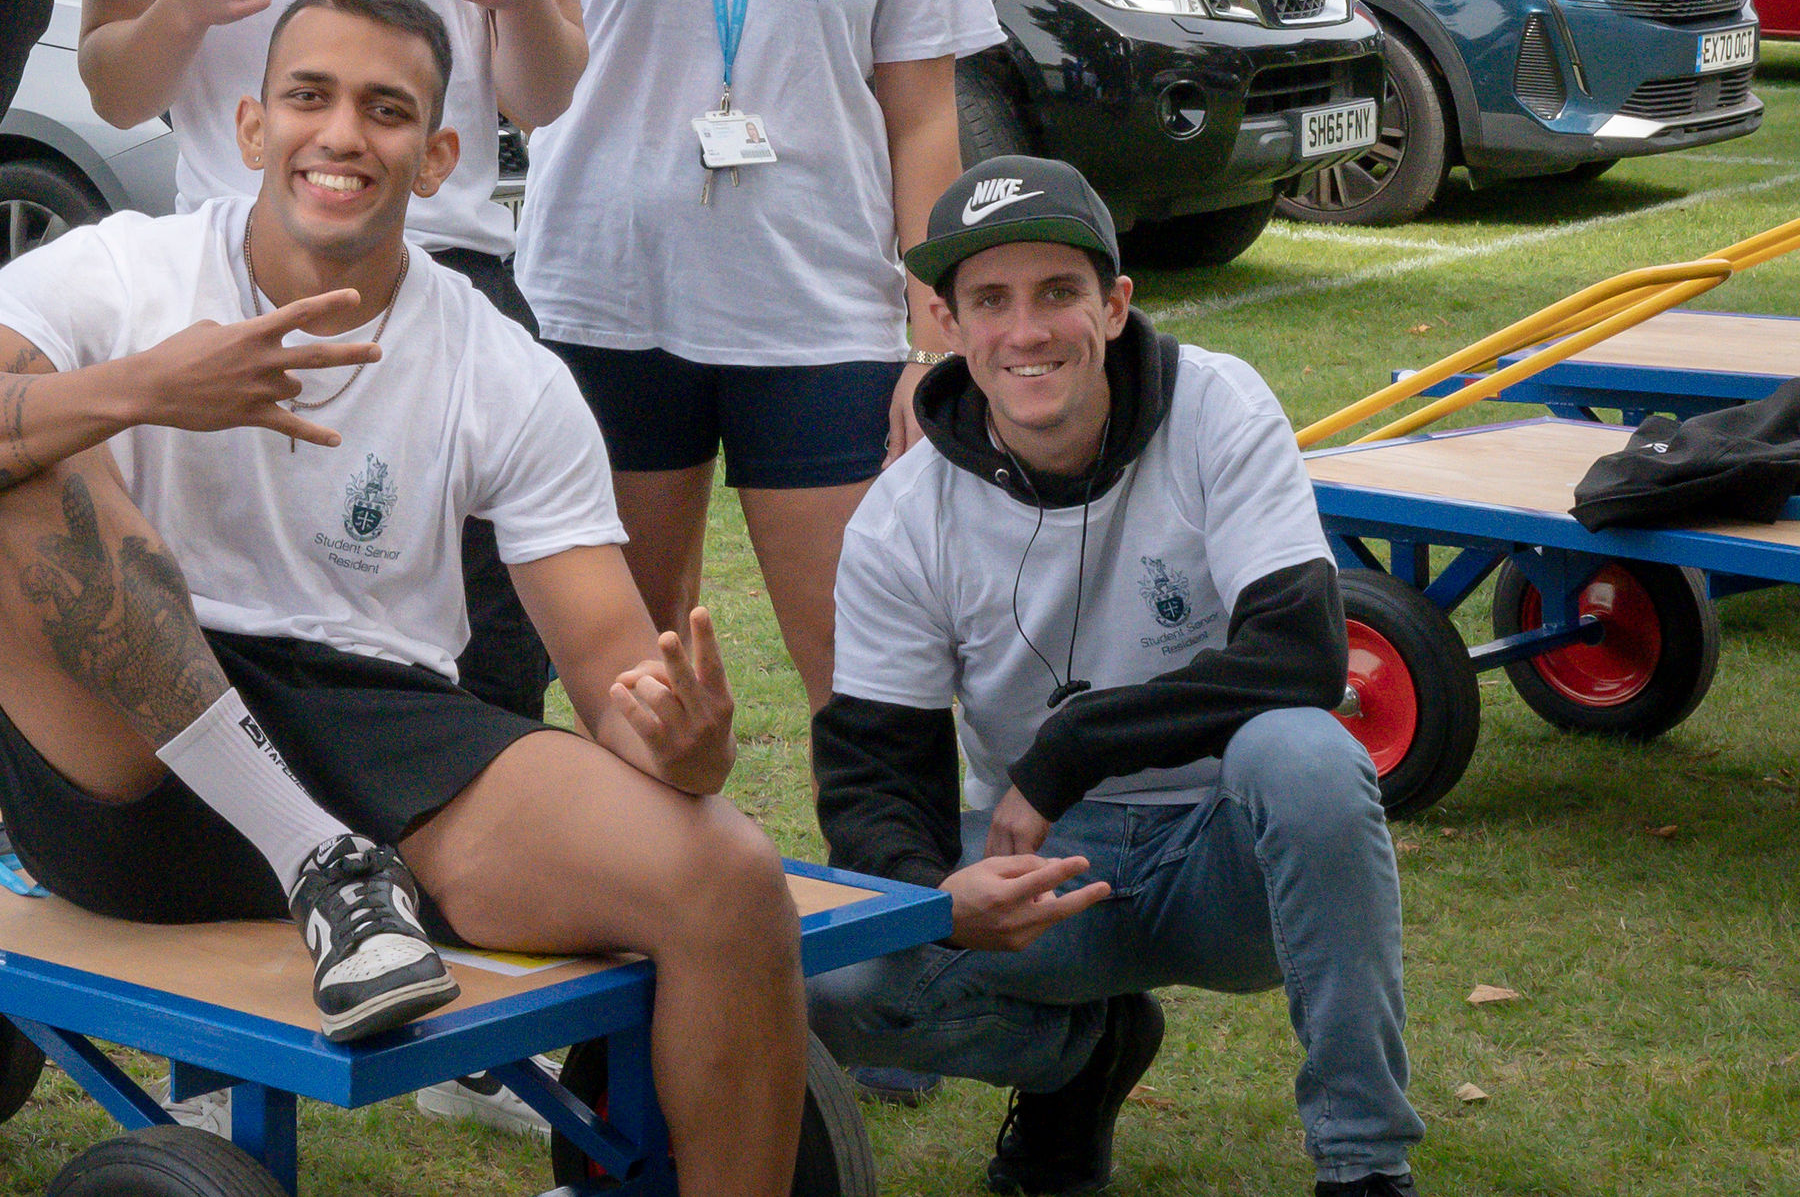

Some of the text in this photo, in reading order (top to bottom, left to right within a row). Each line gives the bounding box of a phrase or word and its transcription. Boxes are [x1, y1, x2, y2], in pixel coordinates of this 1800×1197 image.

[1703, 34, 1733, 64] EX70
[1309, 107, 1371, 148] SH65 FNY
[971, 177, 1024, 207] NIKE
[314, 532, 401, 561] Student Senior
[328, 552, 380, 574] Resident
[1140, 627, 1185, 649] Student
[1161, 630, 1209, 656] Resident
